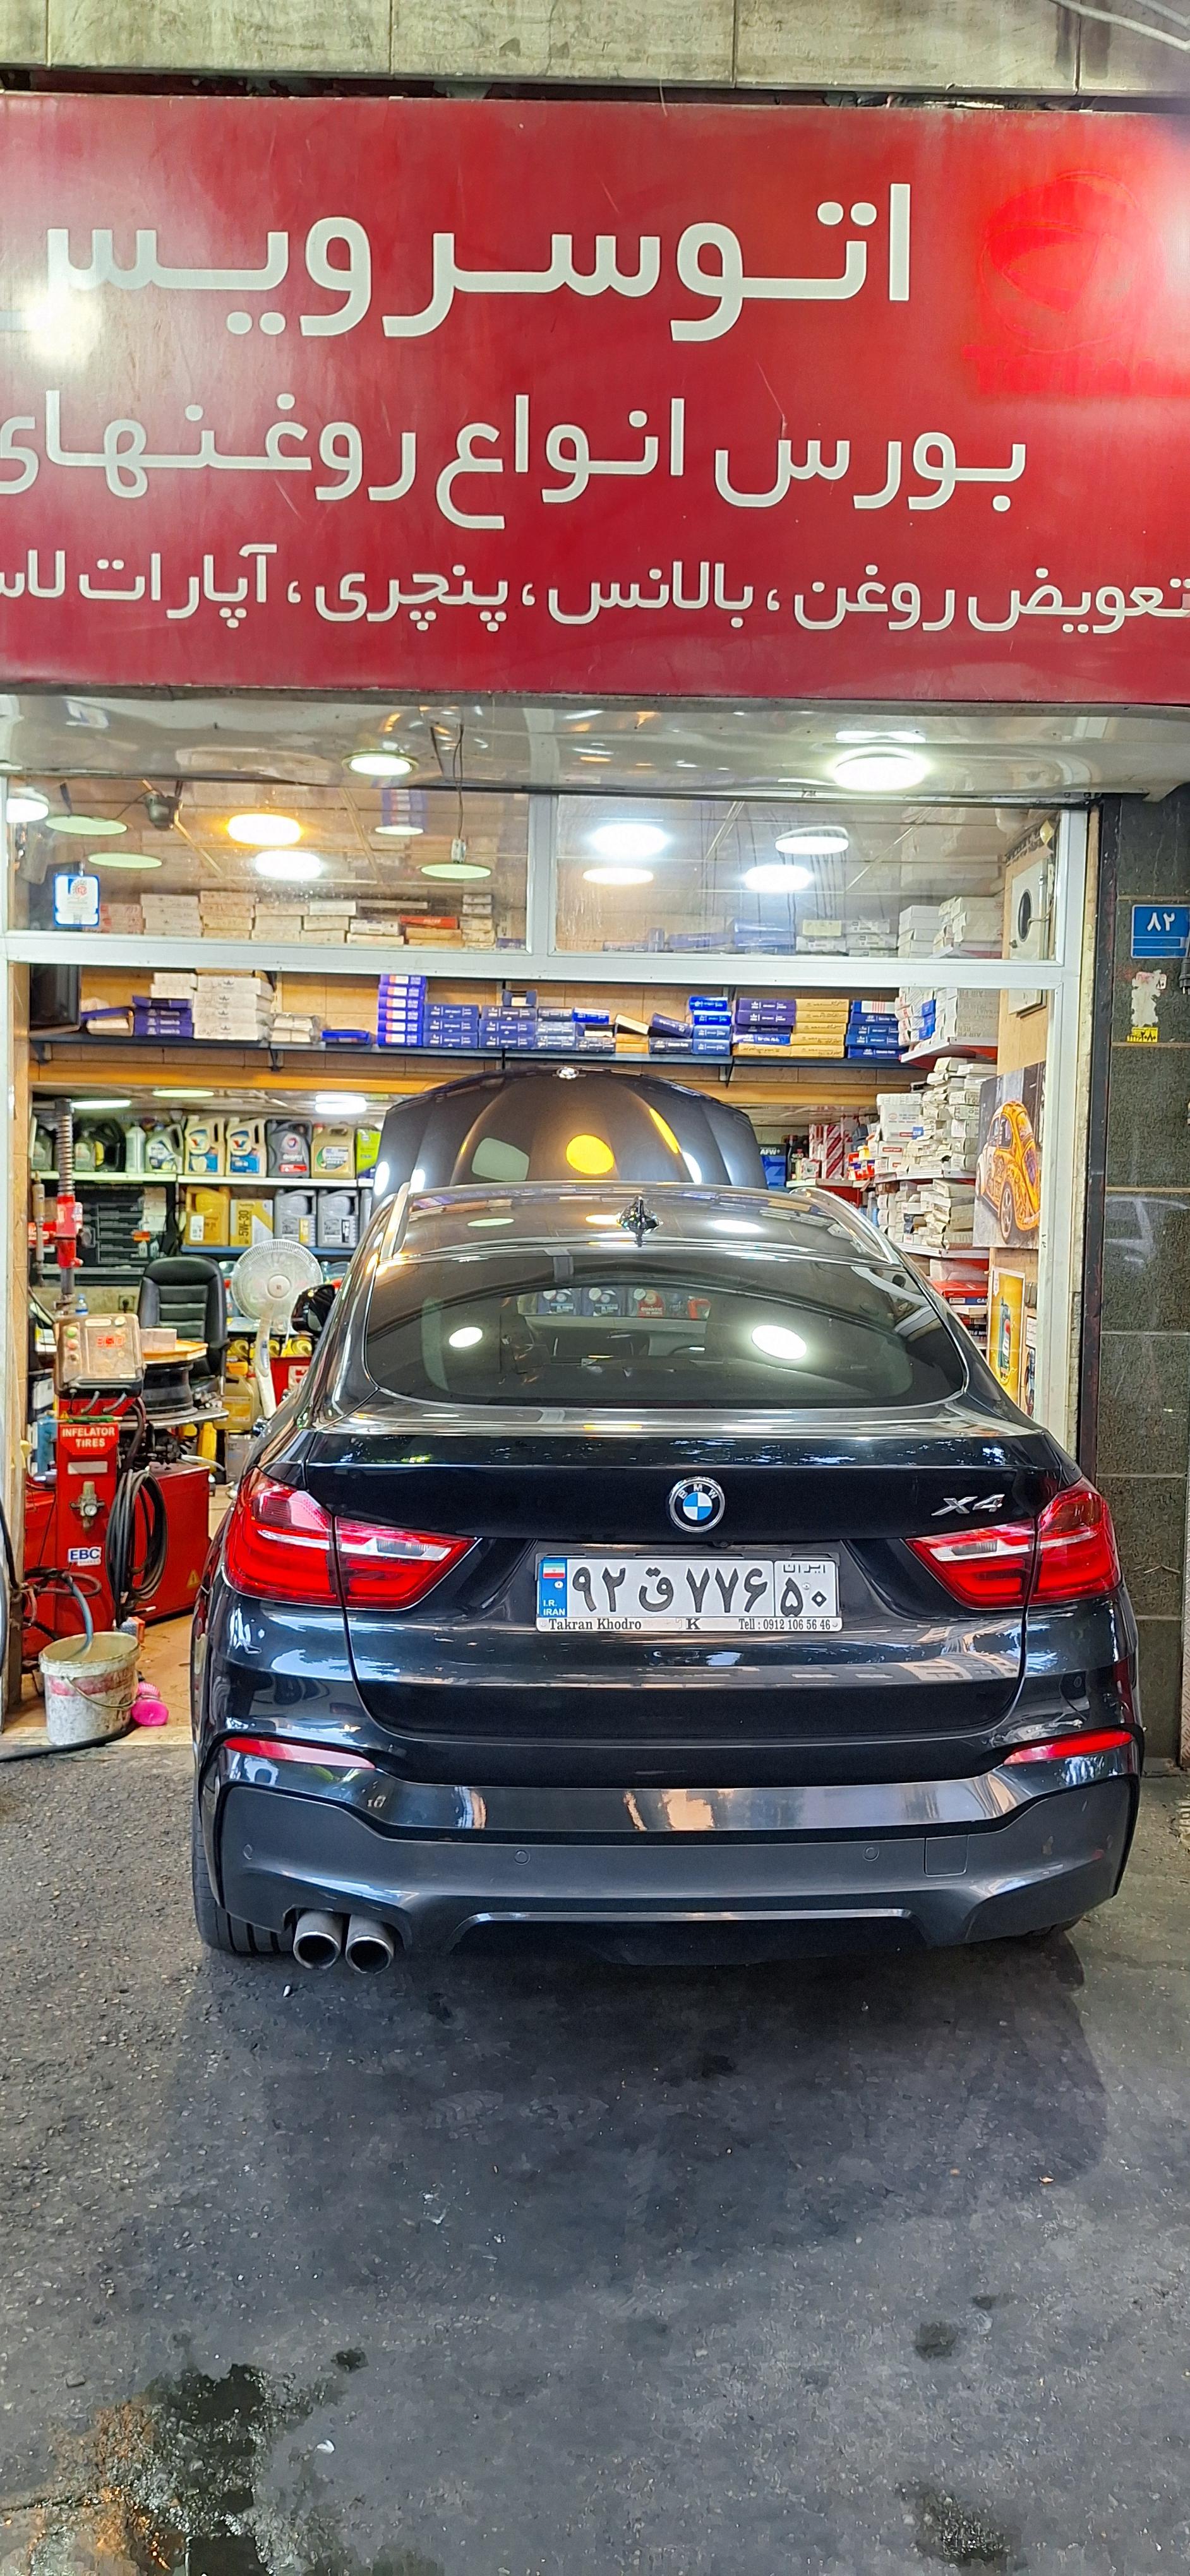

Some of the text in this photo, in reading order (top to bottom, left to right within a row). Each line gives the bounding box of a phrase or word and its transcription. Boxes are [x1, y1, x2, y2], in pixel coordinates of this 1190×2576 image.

[436, 396, 685, 529] انواع
[714, 432, 1026, 513] بورس
[78, 543, 277, 629] آپارات
[548, 560, 754, 629] بالانس
[793, 563, 955, 632] روغن
[315, 563, 508, 635] پنچری
[966, 565, 1190, 634] تعویض
[1147, 912, 1175, 931] ۸۲
[238, 1210, 249, 1237] 5W-30
[62, 1427, 115, 1438] INFELATOR
[75, 1438, 105, 1448] TIRES
[677, 1484, 718, 1500] BMW
[930, 1493, 1005, 1516] X4
[70, 1549, 100, 1561] EBC
[783, 1564, 826, 1573] ایران
[549, 1618, 593, 1630] Takran
[597, 1618, 642, 1630] Khodro
[763, 1619, 784, 1630] 0912
[788, 1619, 803, 1630] 106
[807, 1619, 817, 1630] 56
[820, 1619, 831, 1630] 46
